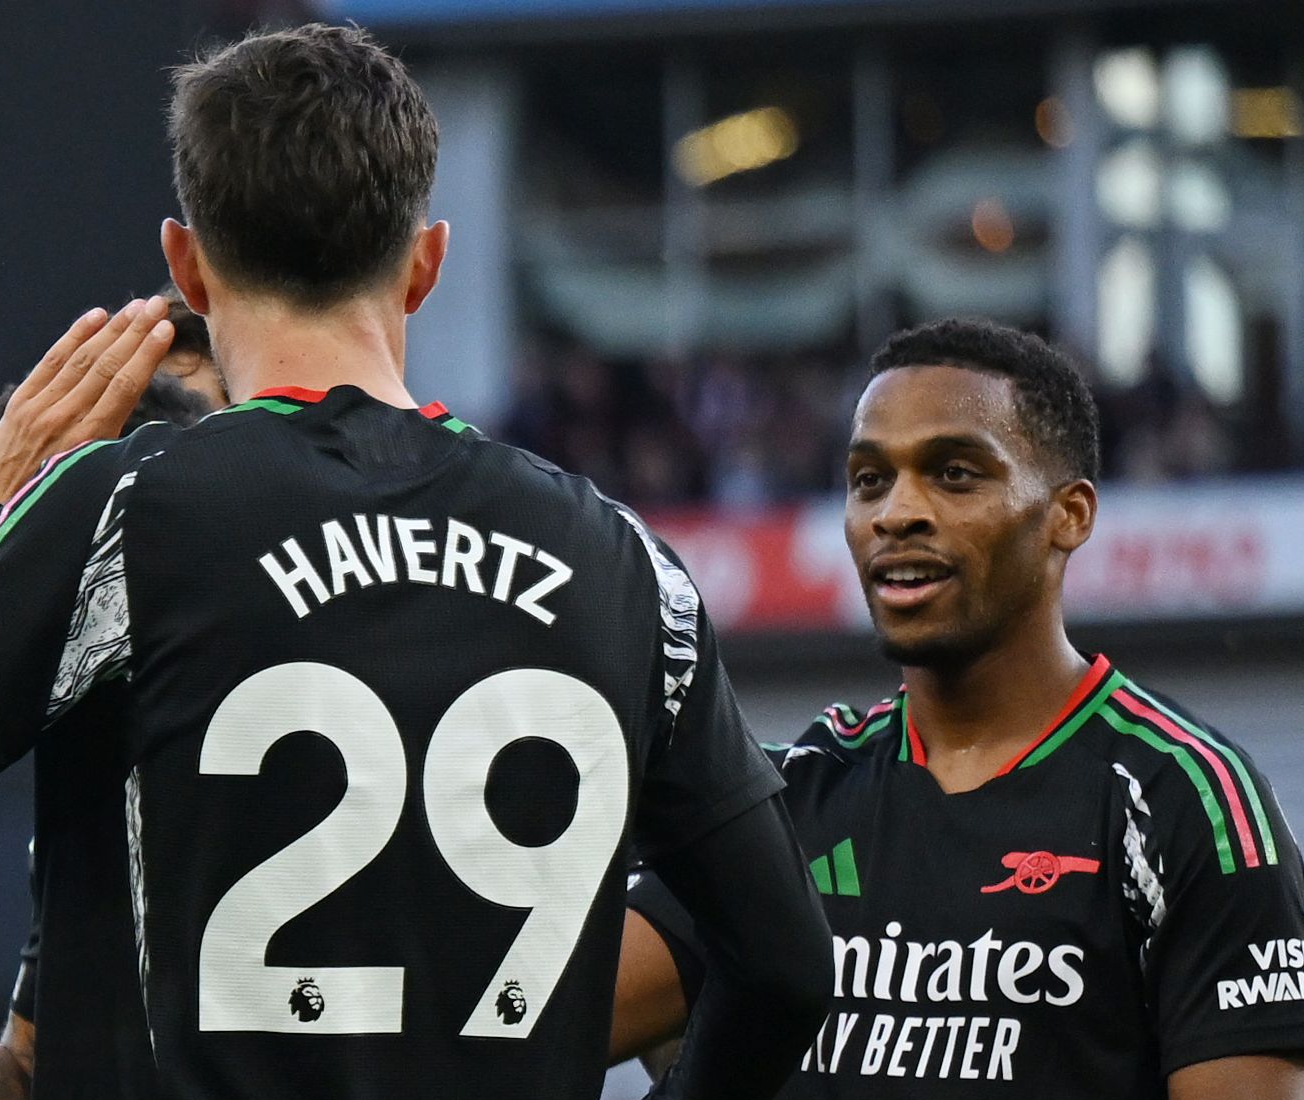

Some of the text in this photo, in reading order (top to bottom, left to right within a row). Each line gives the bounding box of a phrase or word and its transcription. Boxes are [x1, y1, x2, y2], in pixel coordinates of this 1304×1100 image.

[259, 514, 573, 626] HAVERTZ
[198, 661, 629, 1039] 29
[832, 921, 1085, 1006] mirates
[1248, 938, 1304, 970] VIS
[860, 1014, 1021, 1081] BETTER
